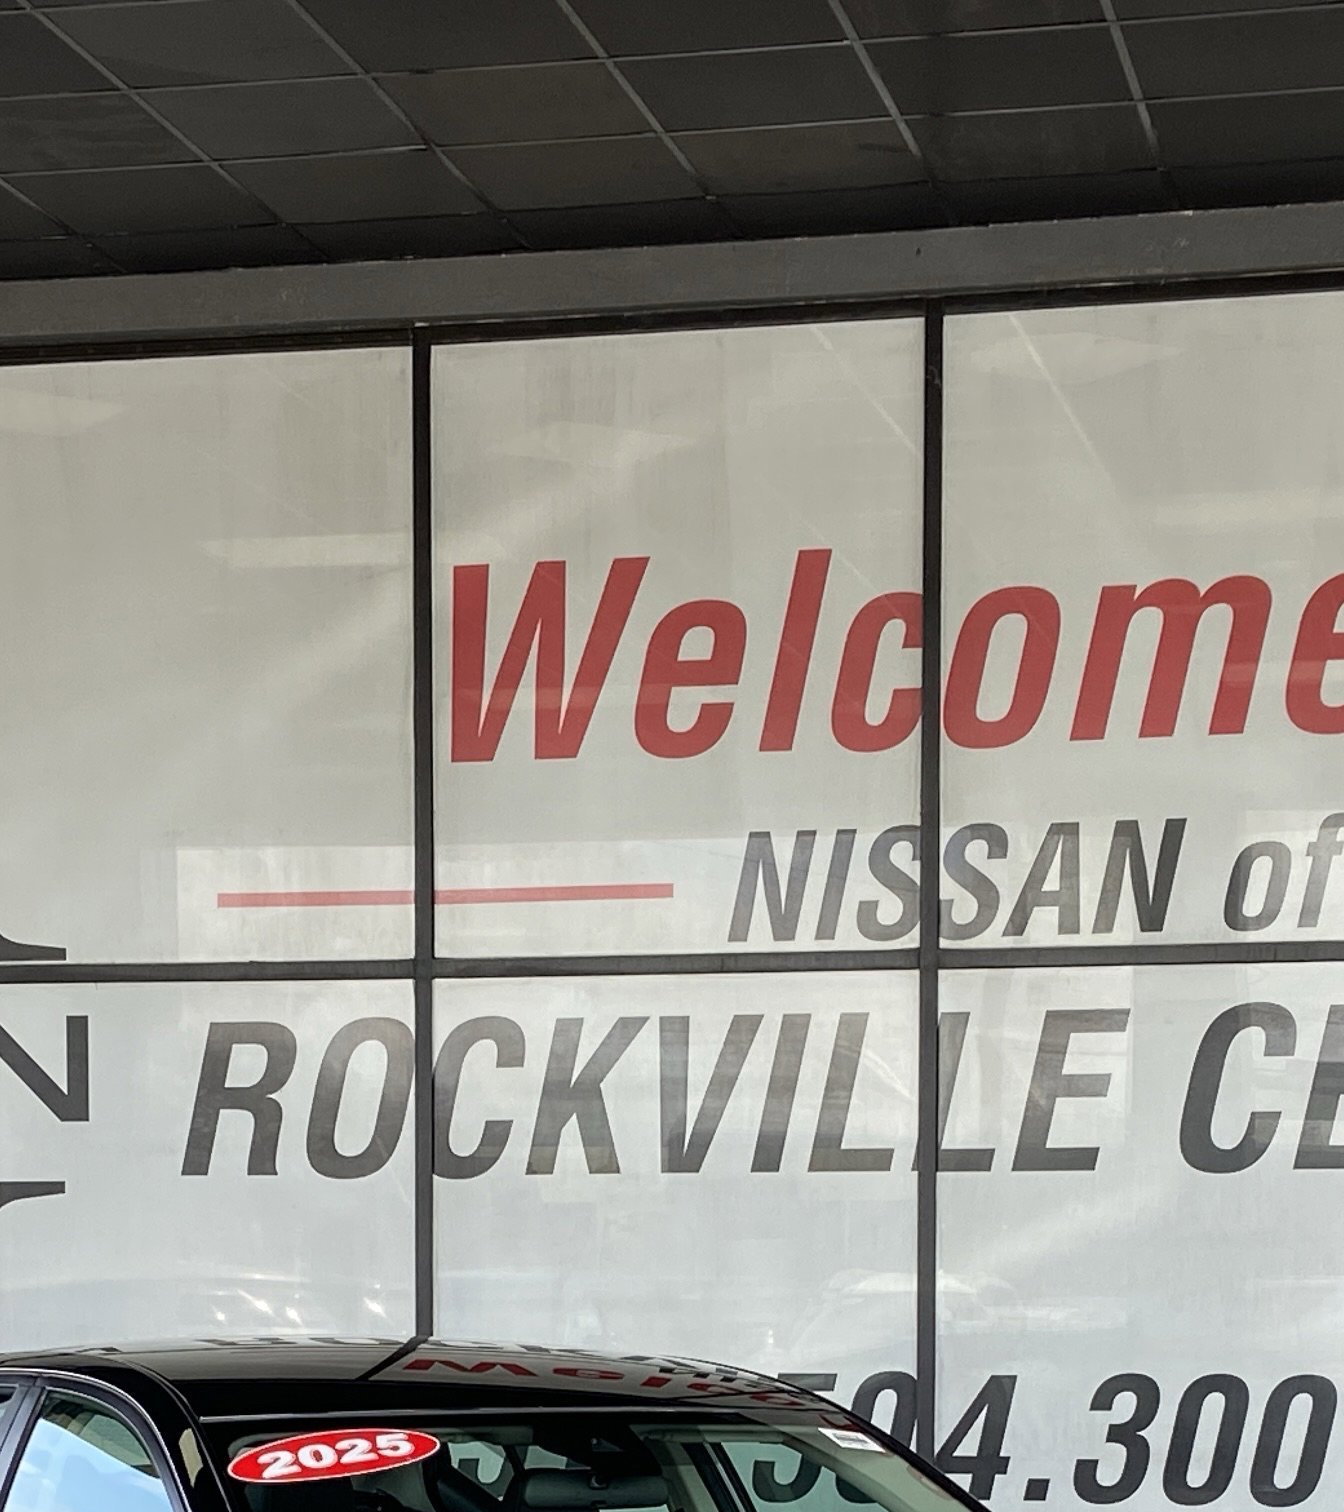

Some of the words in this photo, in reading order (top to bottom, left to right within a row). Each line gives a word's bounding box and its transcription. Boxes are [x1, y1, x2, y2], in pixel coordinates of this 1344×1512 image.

[728, 817, 1189, 942] NISSAN
[182, 1006, 1131, 1178] ROCKVILLE
[256, 1432, 416, 1479] 2025
